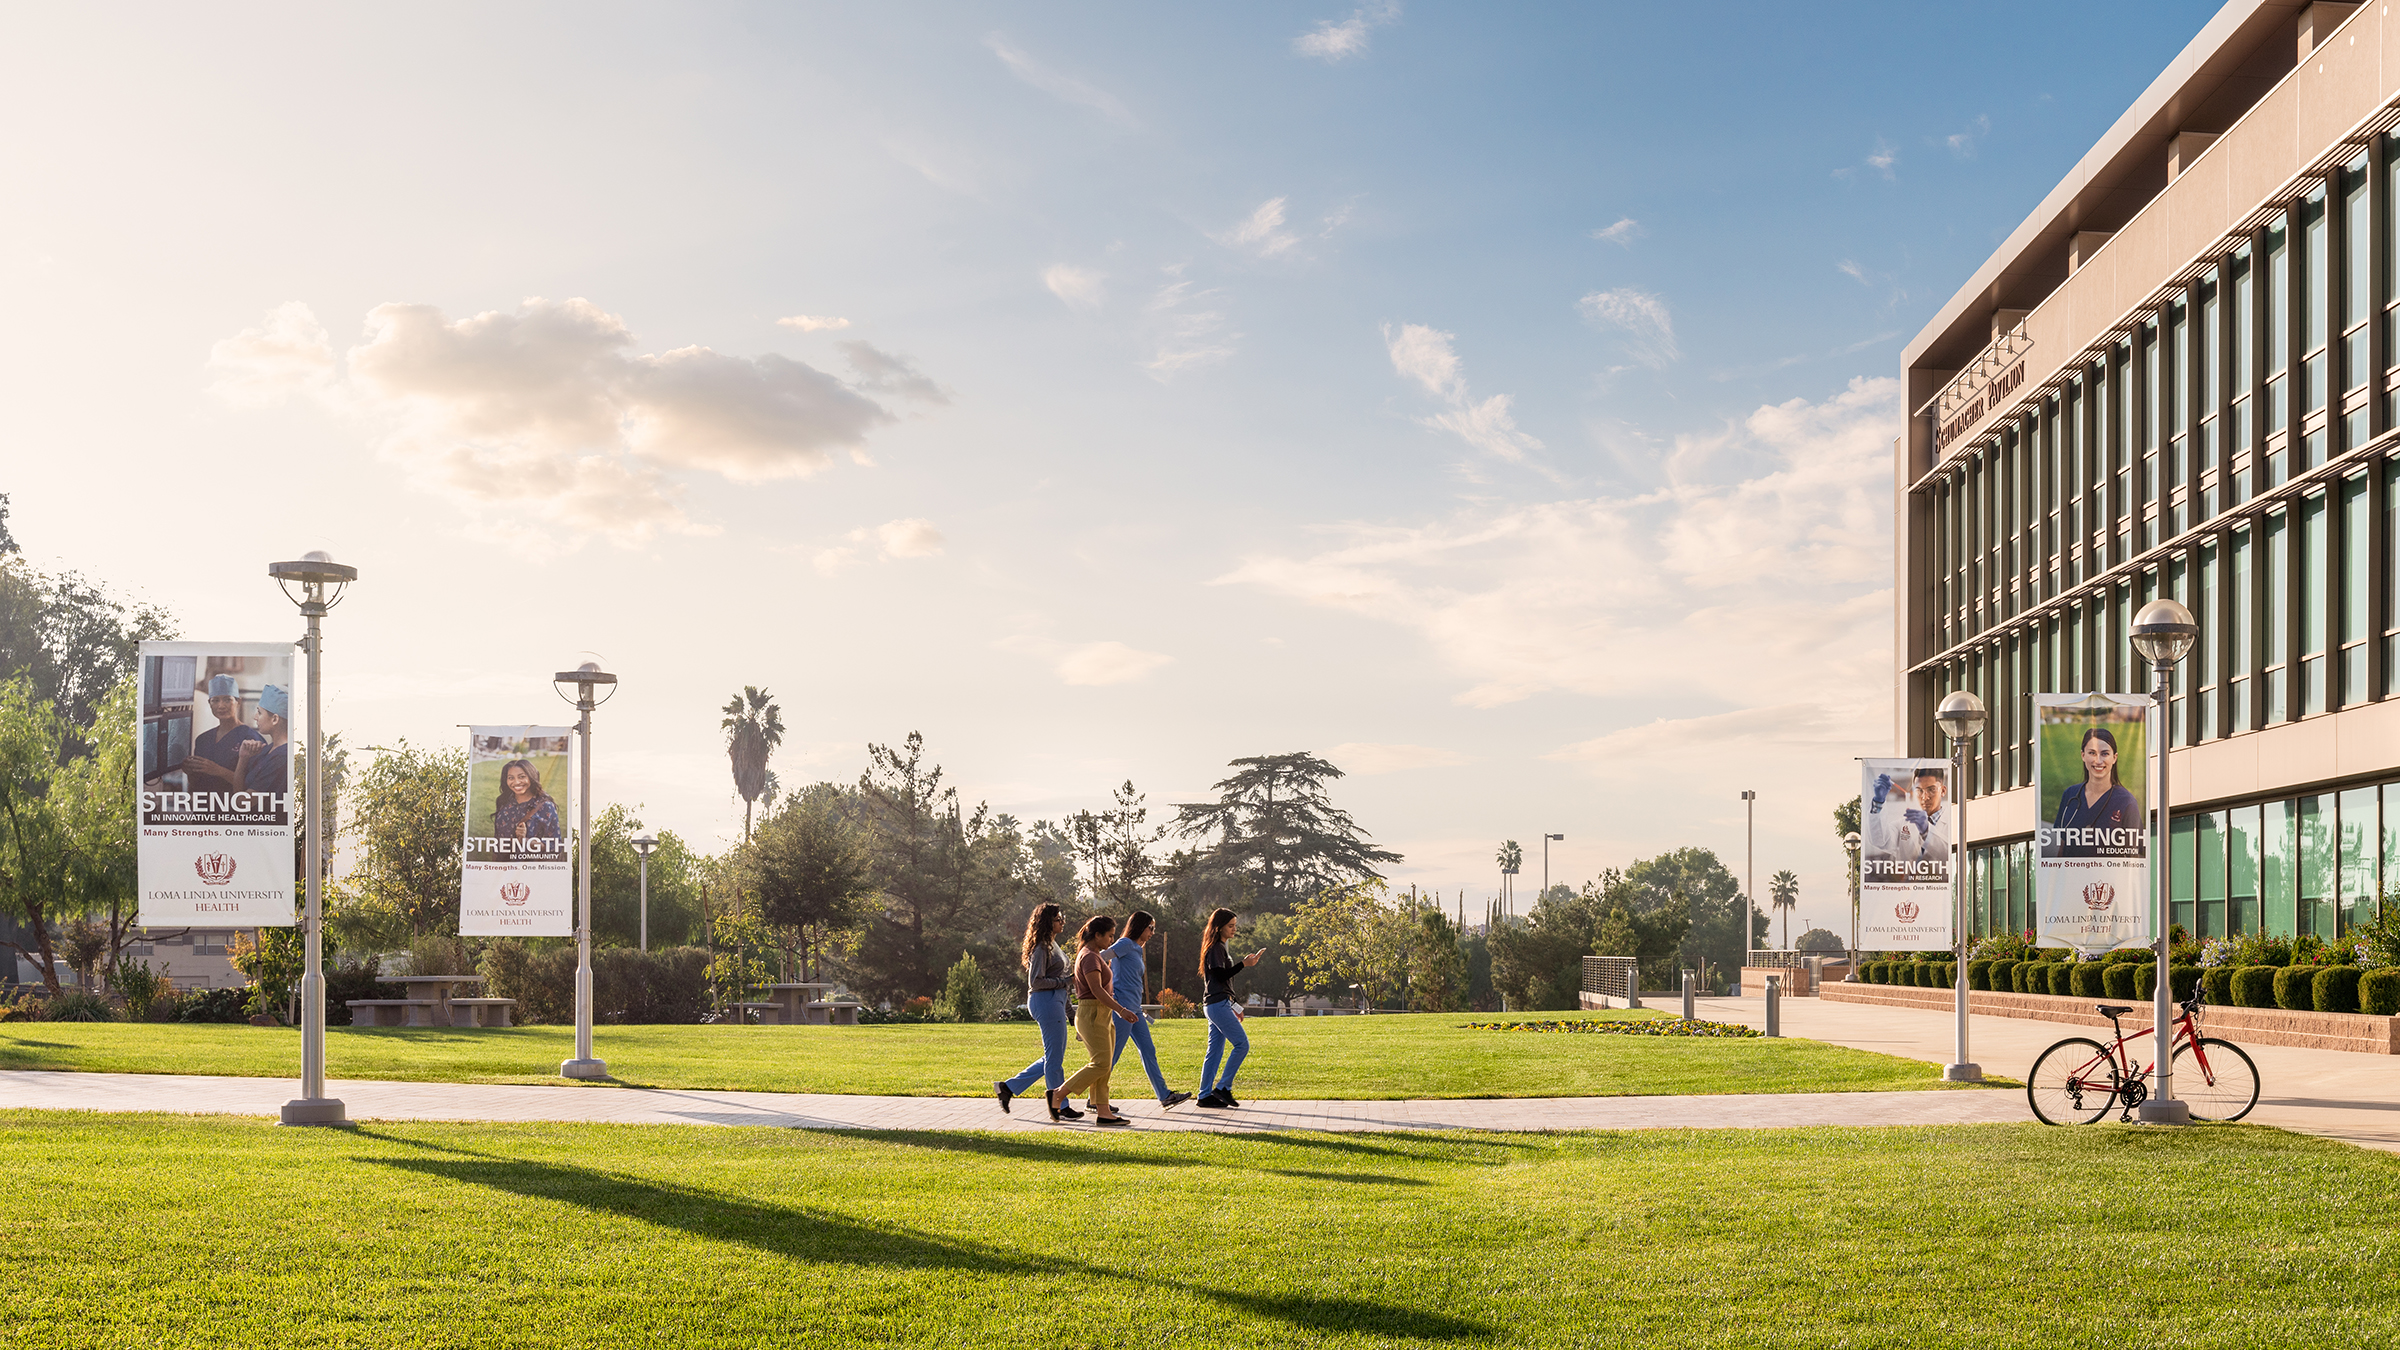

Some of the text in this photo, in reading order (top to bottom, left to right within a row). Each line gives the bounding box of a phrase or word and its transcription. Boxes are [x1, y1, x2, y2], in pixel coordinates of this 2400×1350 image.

[1936, 360, 2025, 454] SCHUMACHER PAVILION
[142, 791, 288, 813] STRENGTH
[151, 813, 276, 822] IN INNOVATIVE HEALTHCARE
[143, 829, 289, 838] Many Strengths. One Mission.
[2040, 828, 2147, 847] STRENGTH
[466, 837, 568, 853] STRENGTH
[2106, 847, 2139, 855] EDUCATION
[484, 864, 520, 872] Strengths.
[1863, 860, 1949, 875] STRENGTH
[2041, 861, 2062, 869] Many
[2064, 861, 2105, 869] Strengths.
[148, 890, 284, 900] LOMA LINDA UNIVERSITY
[195, 903, 239, 912] HEALTH
[466, 909, 565, 917] LOMA LINDA UNIVERSITY
[499, 918, 532, 926] HEALTH
[2044, 915, 2142, 924] LOMA LINDA UNIVERSTY
[2080, 925, 2112, 934] HEALTH
